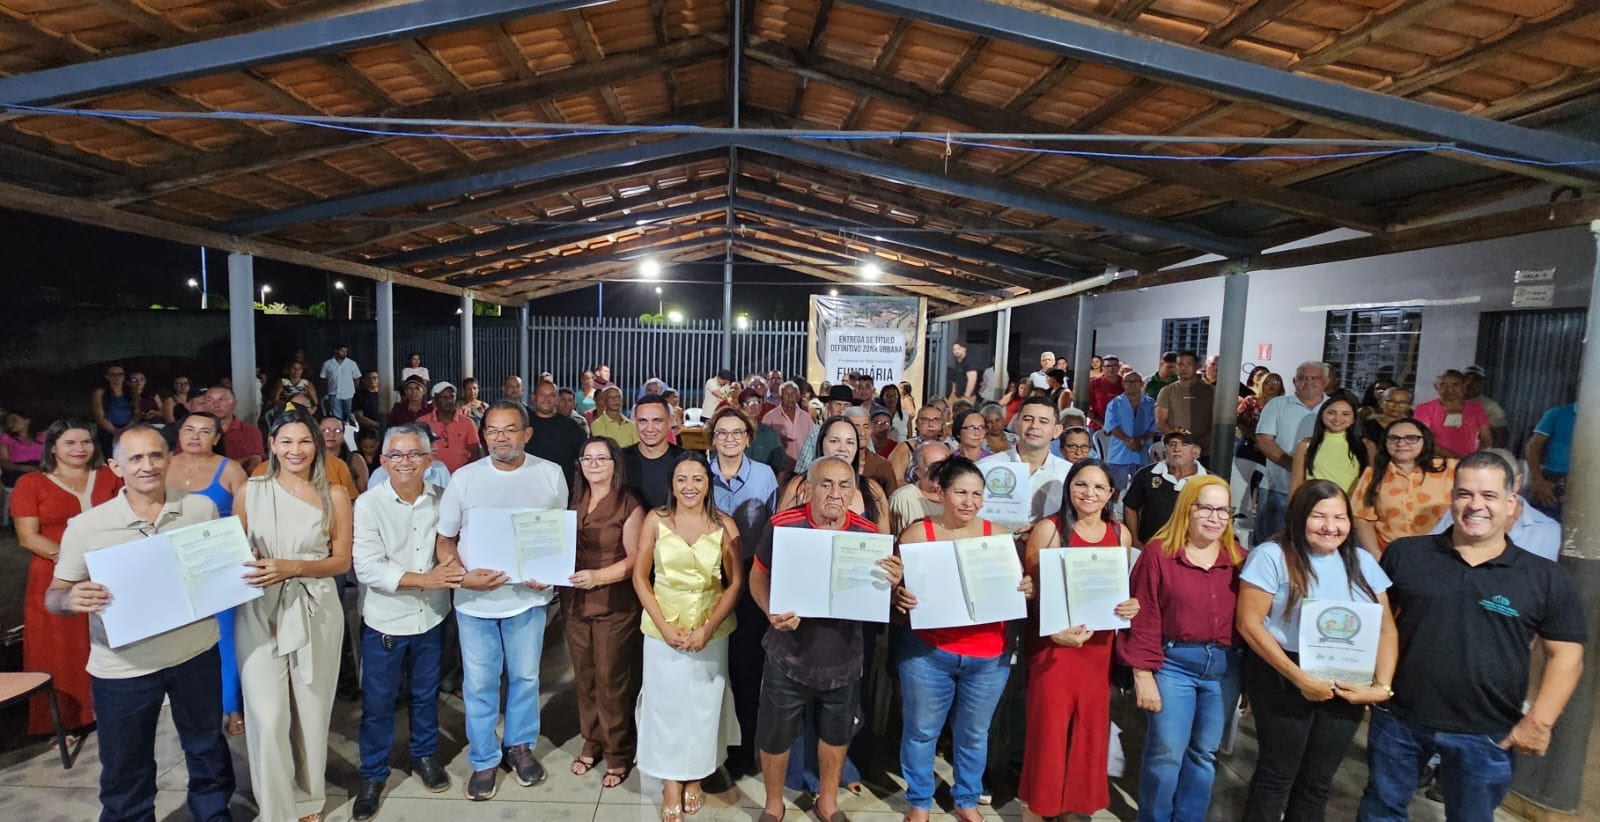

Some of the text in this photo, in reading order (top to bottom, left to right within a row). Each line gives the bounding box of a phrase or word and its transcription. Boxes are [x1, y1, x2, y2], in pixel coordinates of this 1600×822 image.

[839, 335, 865, 344] ENTREGA
[866, 335, 873, 344] DE
[831, 344, 903, 353] DEFINITIVO ZONA URBANA
